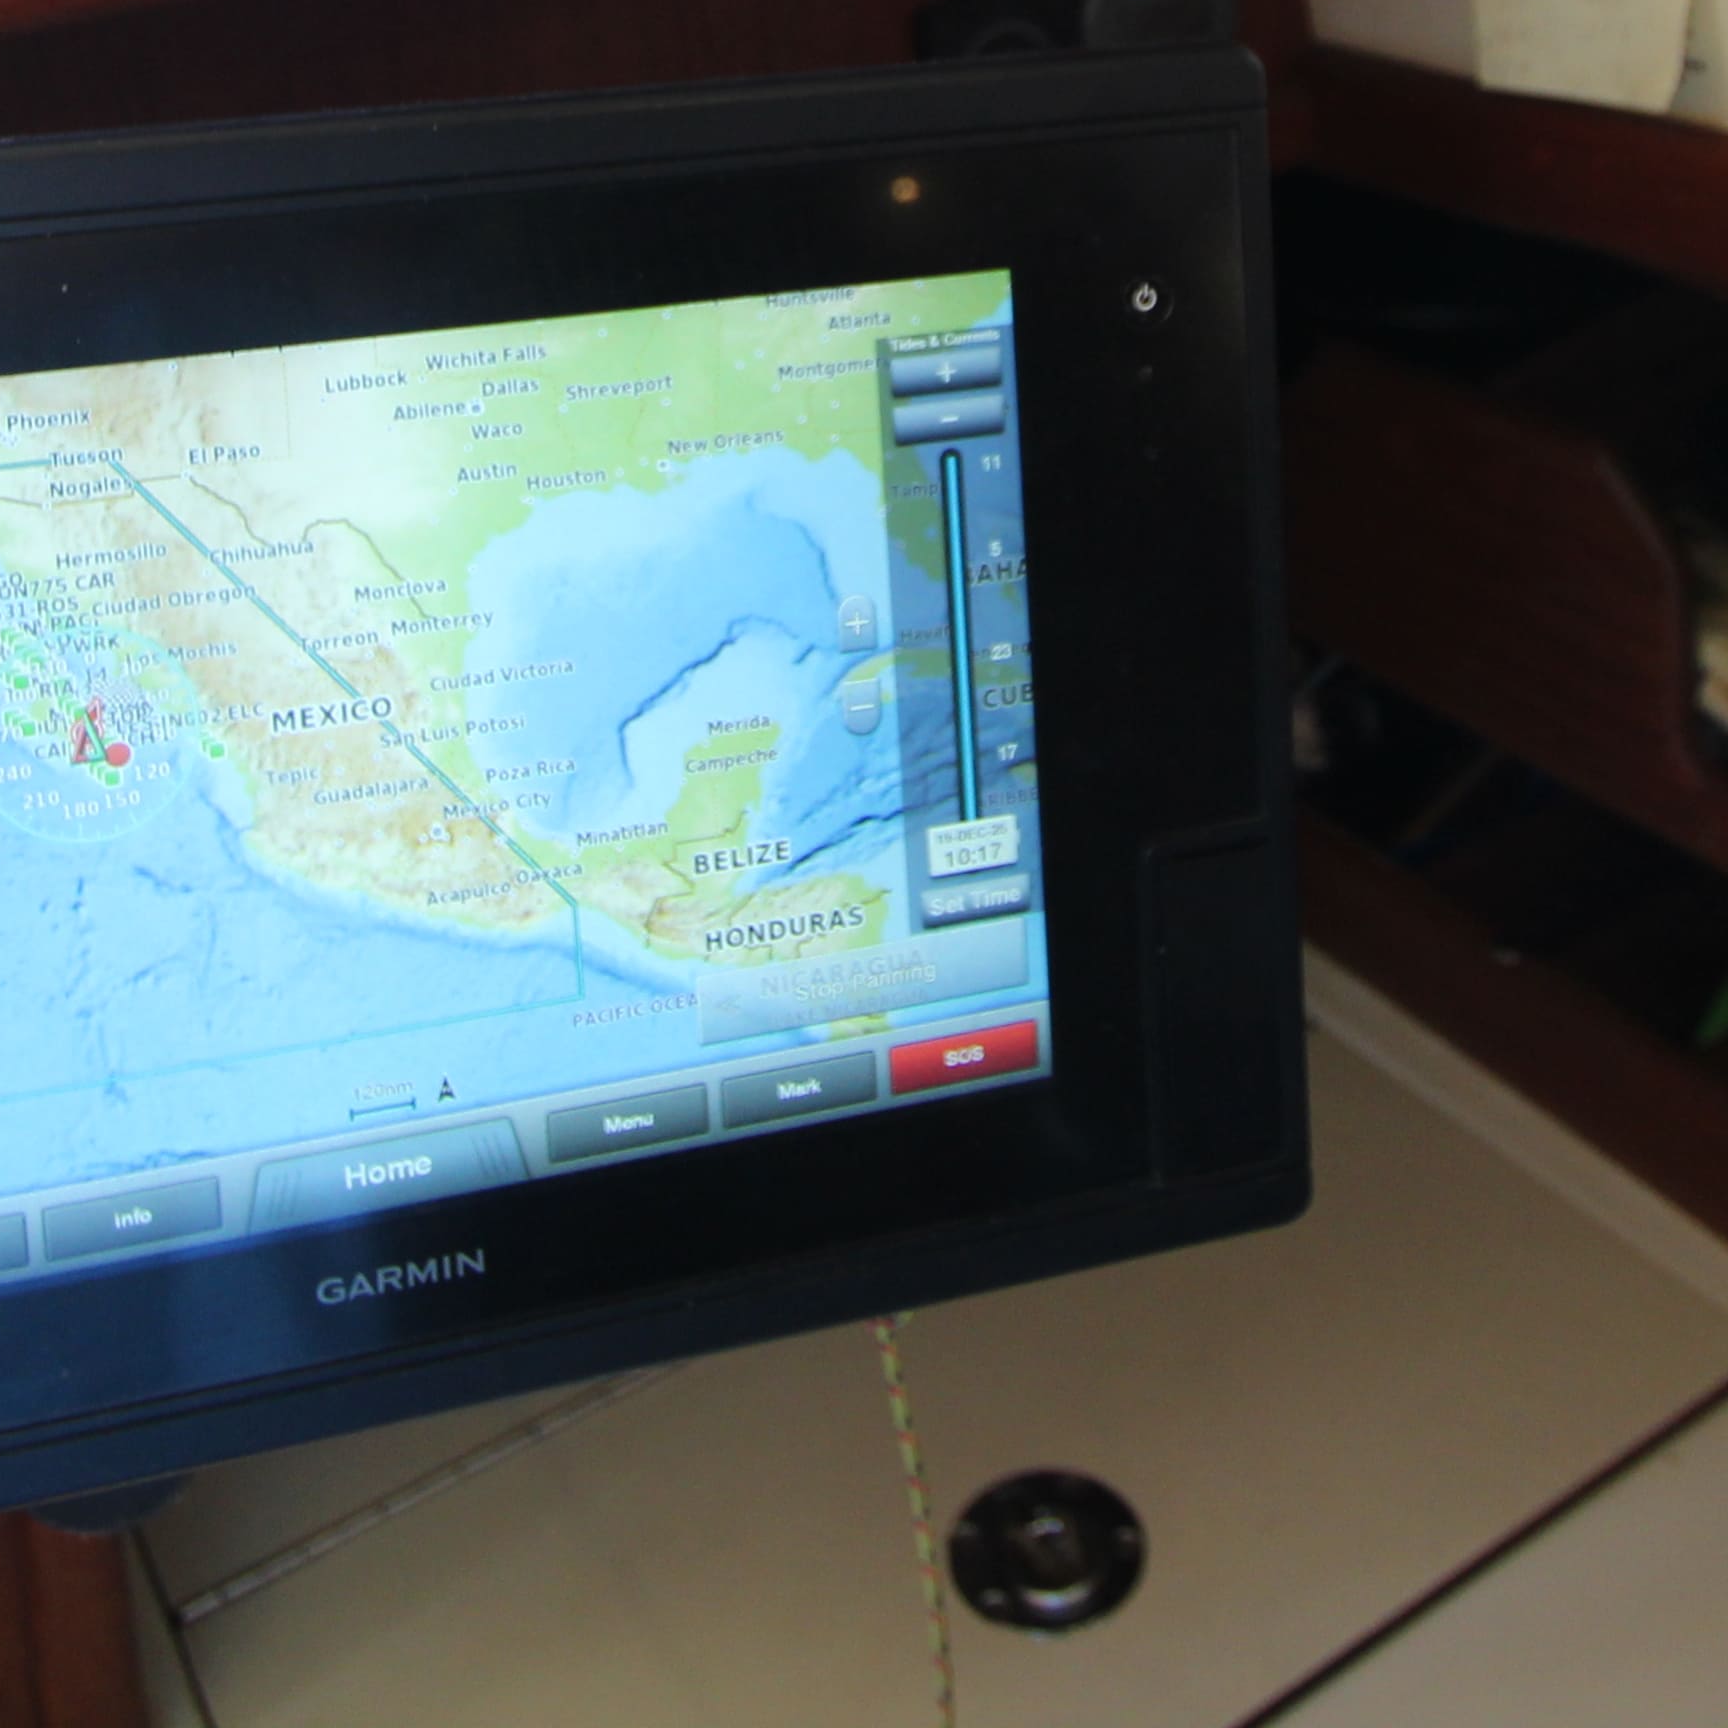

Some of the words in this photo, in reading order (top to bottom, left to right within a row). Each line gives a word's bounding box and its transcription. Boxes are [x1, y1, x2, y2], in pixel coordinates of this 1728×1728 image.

[766, 287, 856, 308] Huntsville
[828, 312, 891, 330] Atlanta
[425, 349, 497, 372] Wichita
[503, 344, 547, 362] Falls
[325, 370, 408, 394] Lubbock
[481, 379, 540, 397] Dallas
[566, 375, 673, 401] Shreveport
[7, 408, 91, 432] Phoenix
[393, 400, 466, 421] Abilene
[471, 422, 523, 441] Waco
[667, 439, 708, 455] New
[714, 429, 785, 450] Orleans
[50, 447, 124, 470] Tucson
[188, 448, 207, 466] El
[214, 443, 261, 462] Paso
[456, 462, 518, 484] Austin
[526, 469, 607, 491] Houston
[49, 474, 133, 500] Nogales
[56, 542, 168, 570] Hermosillo
[209, 540, 316, 564] Chihuahua
[91, 591, 162, 618] Ciudad
[167, 583, 257, 609] Obregon
[354, 578, 447, 603] Monclova
[390, 612, 495, 637] Monterrey
[167, 641, 238, 663] Mochis
[301, 629, 380, 654] Torreon
[430, 670, 495, 692] Ciudad
[499, 661, 574, 683] Victoria
[271, 697, 392, 734] MEXICO
[707, 715, 772, 736] Merida
[380, 730, 416, 749] San
[422, 726, 461, 744] Luis
[465, 716, 526, 737] Potosi
[685, 747, 779, 773] Campeche
[997, 743, 1018, 761] 17
[133, 762, 171, 782] 120
[266, 768, 319, 787] Tepic
[485, 766, 531, 784] Poza
[537, 759, 576, 777] Rica
[22, 790, 61, 810] 210
[103, 790, 142, 810] 150
[313, 777, 430, 806] Guadalajara
[62, 801, 100, 821] 180
[442, 799, 510, 821] Mexico
[515, 792, 552, 810] City
[576, 822, 670, 848] Minatitlan
[693, 840, 792, 875] BELIZE
[944, 842, 1005, 870] 10:17
[515, 863, 583, 885] Oaxaca
[426, 881, 511, 908] Acapulco
[928, 896, 965, 917] Set
[969, 886, 1021, 910] Time
[705, 906, 865, 952] HONDURAS
[794, 974, 845, 1003] Stop
[851, 962, 938, 991] Panning
[572, 1004, 645, 1029] PACIFIC
[650, 992, 700, 1014] OCEA
[943, 1045, 986, 1067] SOS
[777, 1077, 823, 1101] Mark
[603, 1112, 655, 1135] Menu
[344, 1154, 433, 1190] Home
[316, 1248, 486, 1305] GARMIN
